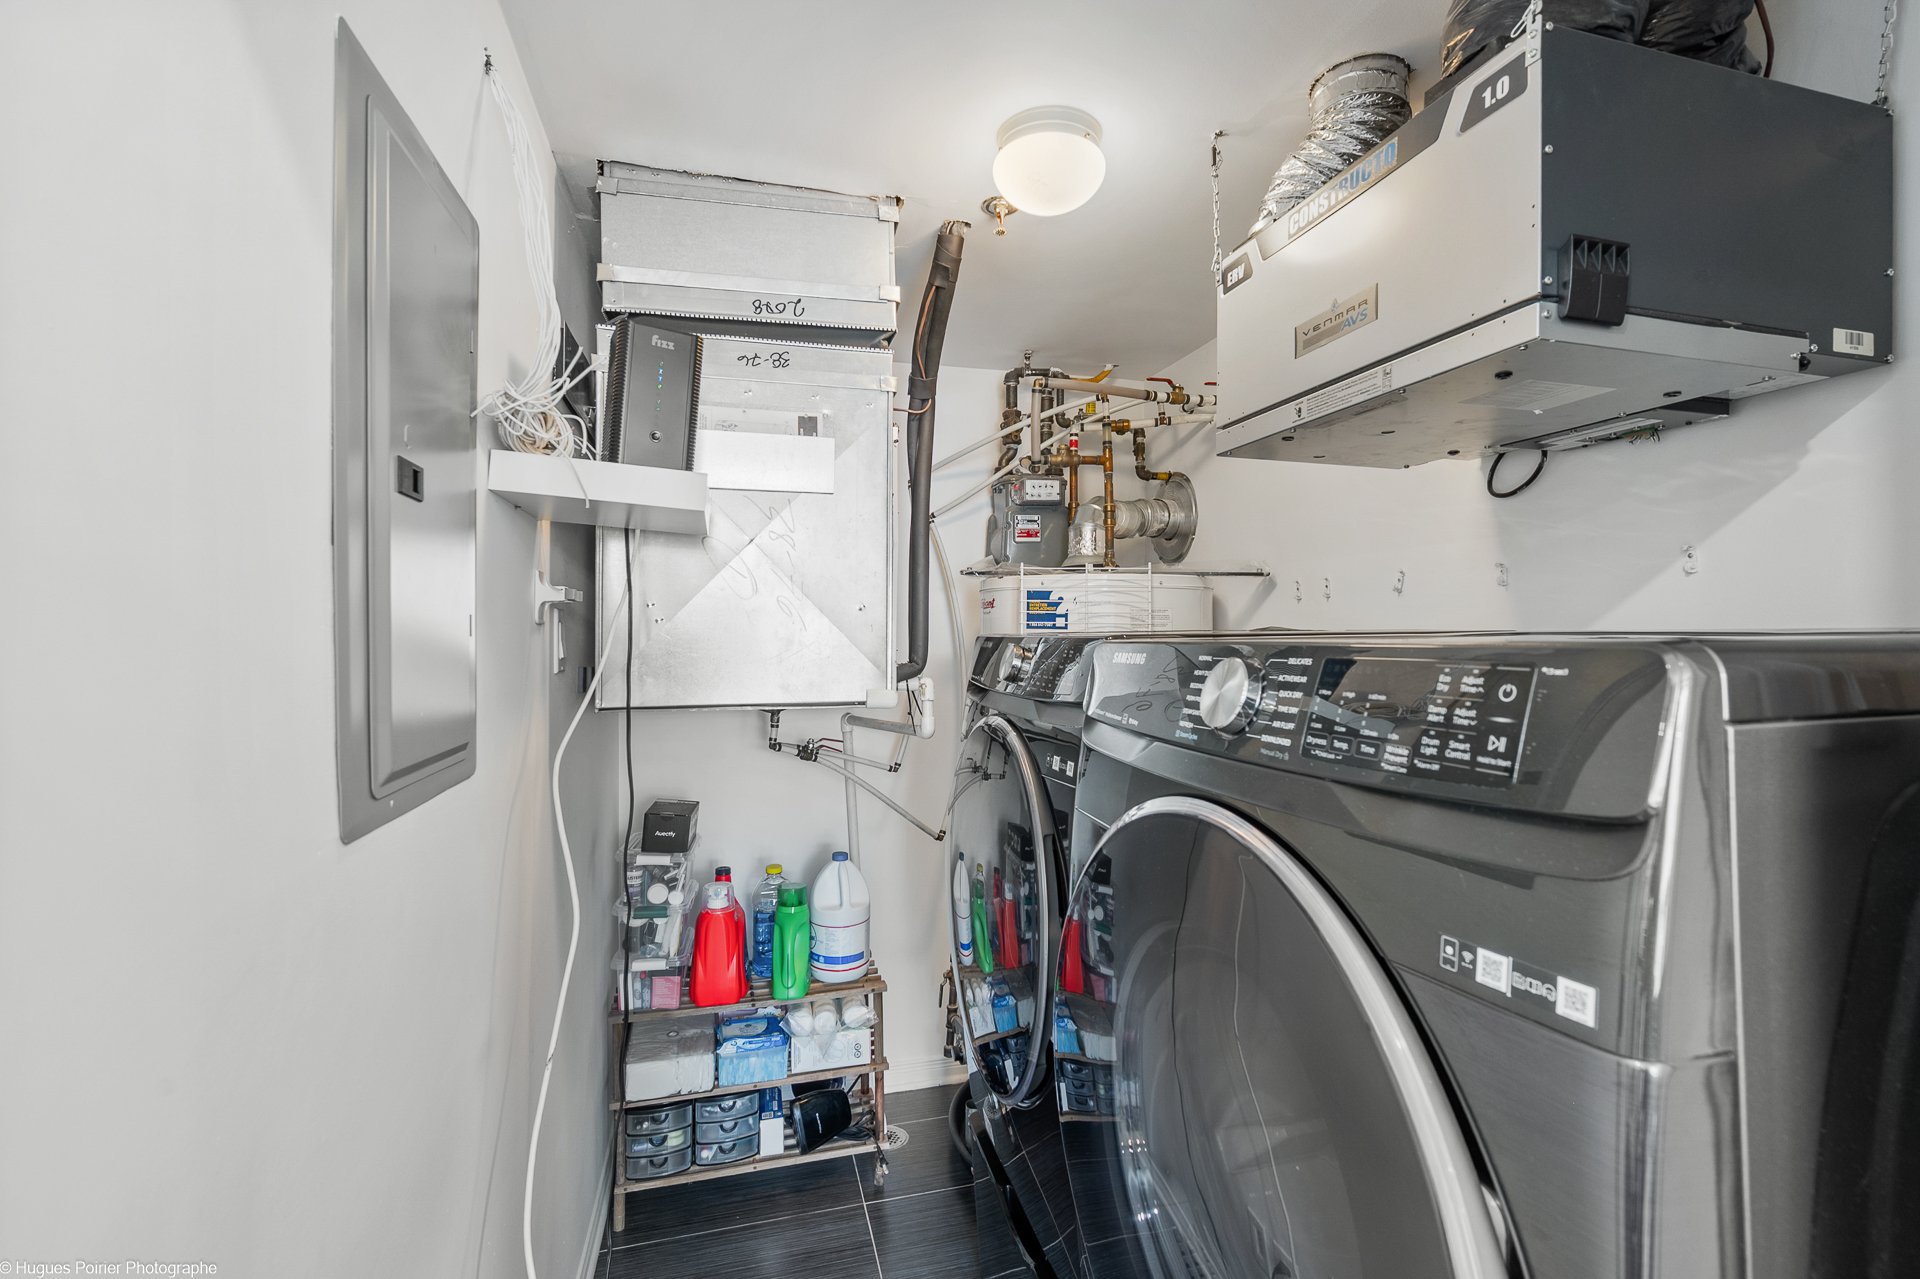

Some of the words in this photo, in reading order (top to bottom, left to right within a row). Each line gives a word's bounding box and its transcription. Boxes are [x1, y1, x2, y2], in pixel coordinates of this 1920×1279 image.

[1481, 75, 1510, 109] 1.0
[1288, 141, 1397, 235] CONSTRUCTO
[1226, 262, 1246, 288] ERV
[1302, 298, 1369, 337] VENMAR
[1340, 307, 1369, 333] AVS
[651, 334, 676, 351] fizz
[1112, 652, 1148, 665] SAMSUNG
[1461, 675, 1486, 686] Adjust
[1436, 682, 1450, 693] Dry
[1453, 707, 1477, 718] Adjust
[1305, 735, 1328, 746] Dryness
[1448, 739, 1471, 751] Smart
[1360, 743, 1376, 756] Time
[1444, 748, 1471, 761] Control
